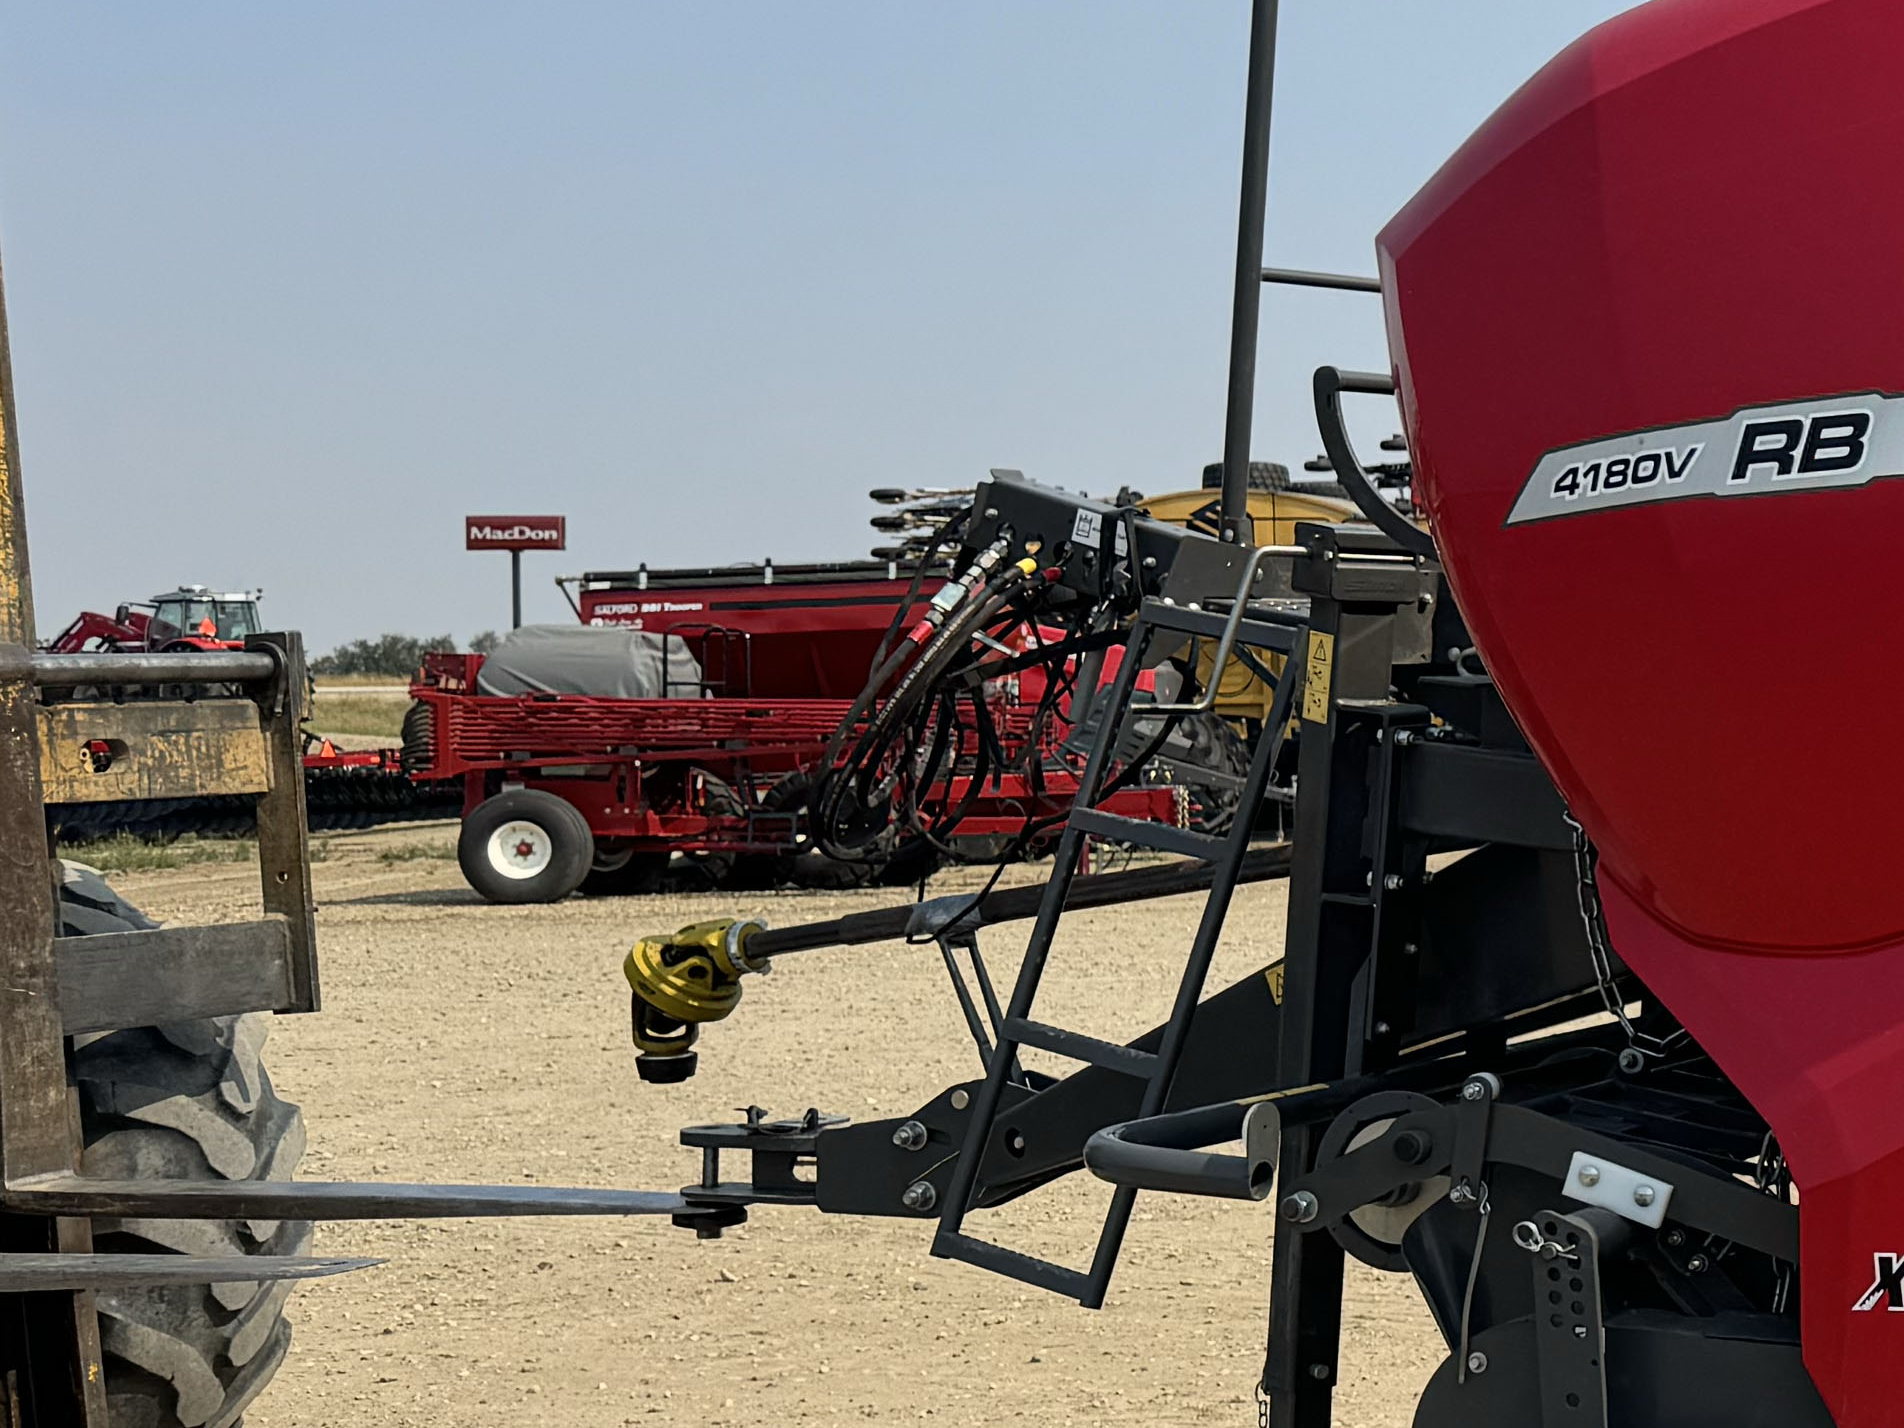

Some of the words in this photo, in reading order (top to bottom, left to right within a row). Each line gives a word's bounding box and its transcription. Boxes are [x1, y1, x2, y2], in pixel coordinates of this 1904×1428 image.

[1553, 446, 1699, 496] 4180V
[1730, 412, 1871, 481] RB
[470, 525, 558, 541] MacDon
